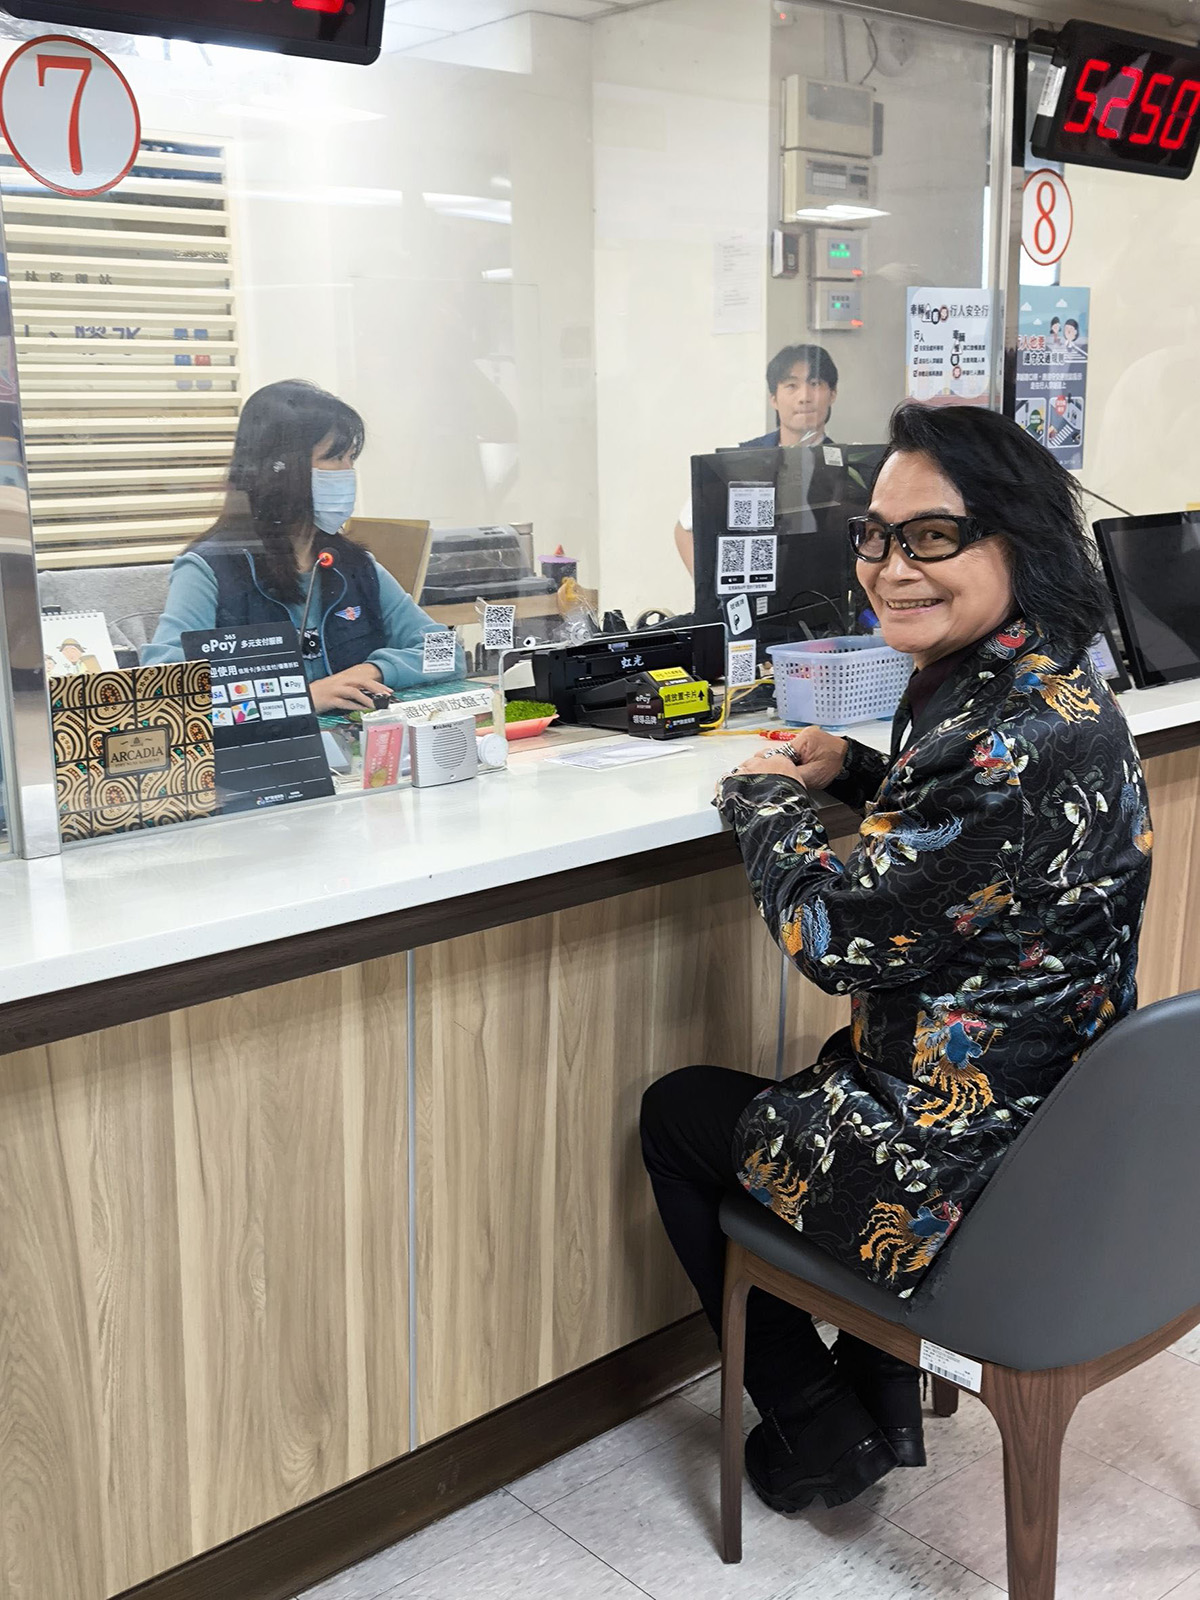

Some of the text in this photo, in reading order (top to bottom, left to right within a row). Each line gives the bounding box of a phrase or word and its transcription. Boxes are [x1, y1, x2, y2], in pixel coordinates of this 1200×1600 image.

[1064, 58, 1200, 150] 5250
[36, 54, 93, 176] 7
[1034, 181, 1056, 255] 8
[201, 639, 237, 653] ePay
[621, 654, 645, 669] 虹光
[664, 690, 697, 703] 請放置卡片
[110, 746, 164, 764] ARCADIA
